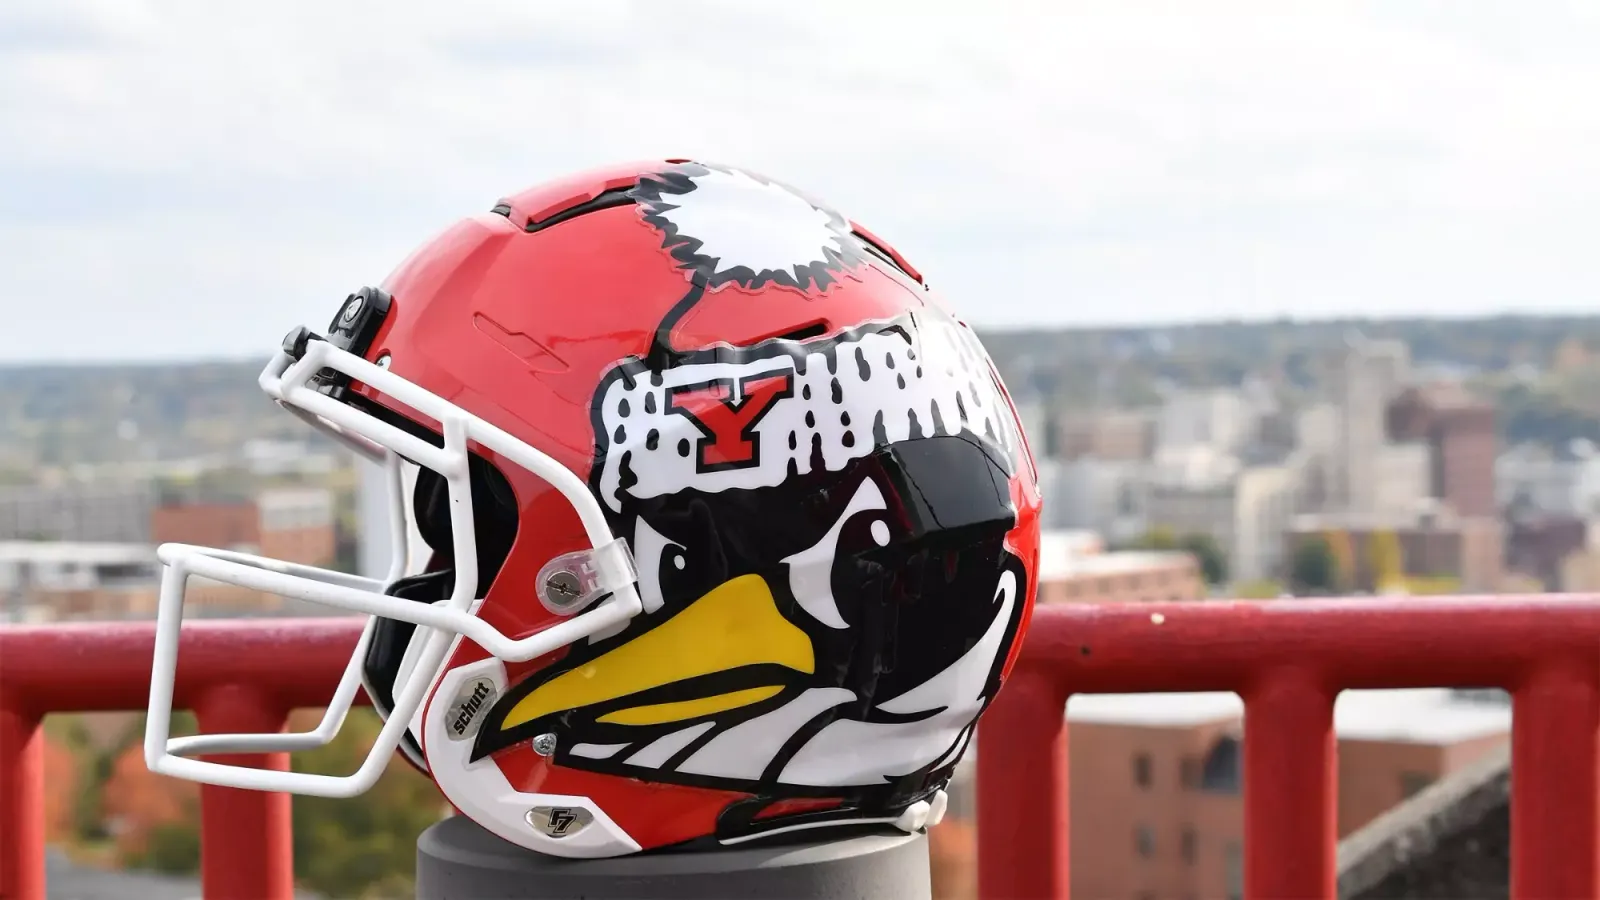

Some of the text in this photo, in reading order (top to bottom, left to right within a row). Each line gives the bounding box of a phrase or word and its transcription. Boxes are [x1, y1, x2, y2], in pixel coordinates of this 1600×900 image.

[664, 367, 794, 474] Y
[453, 681, 490, 735] schutt
[548, 808, 577, 833] F7
